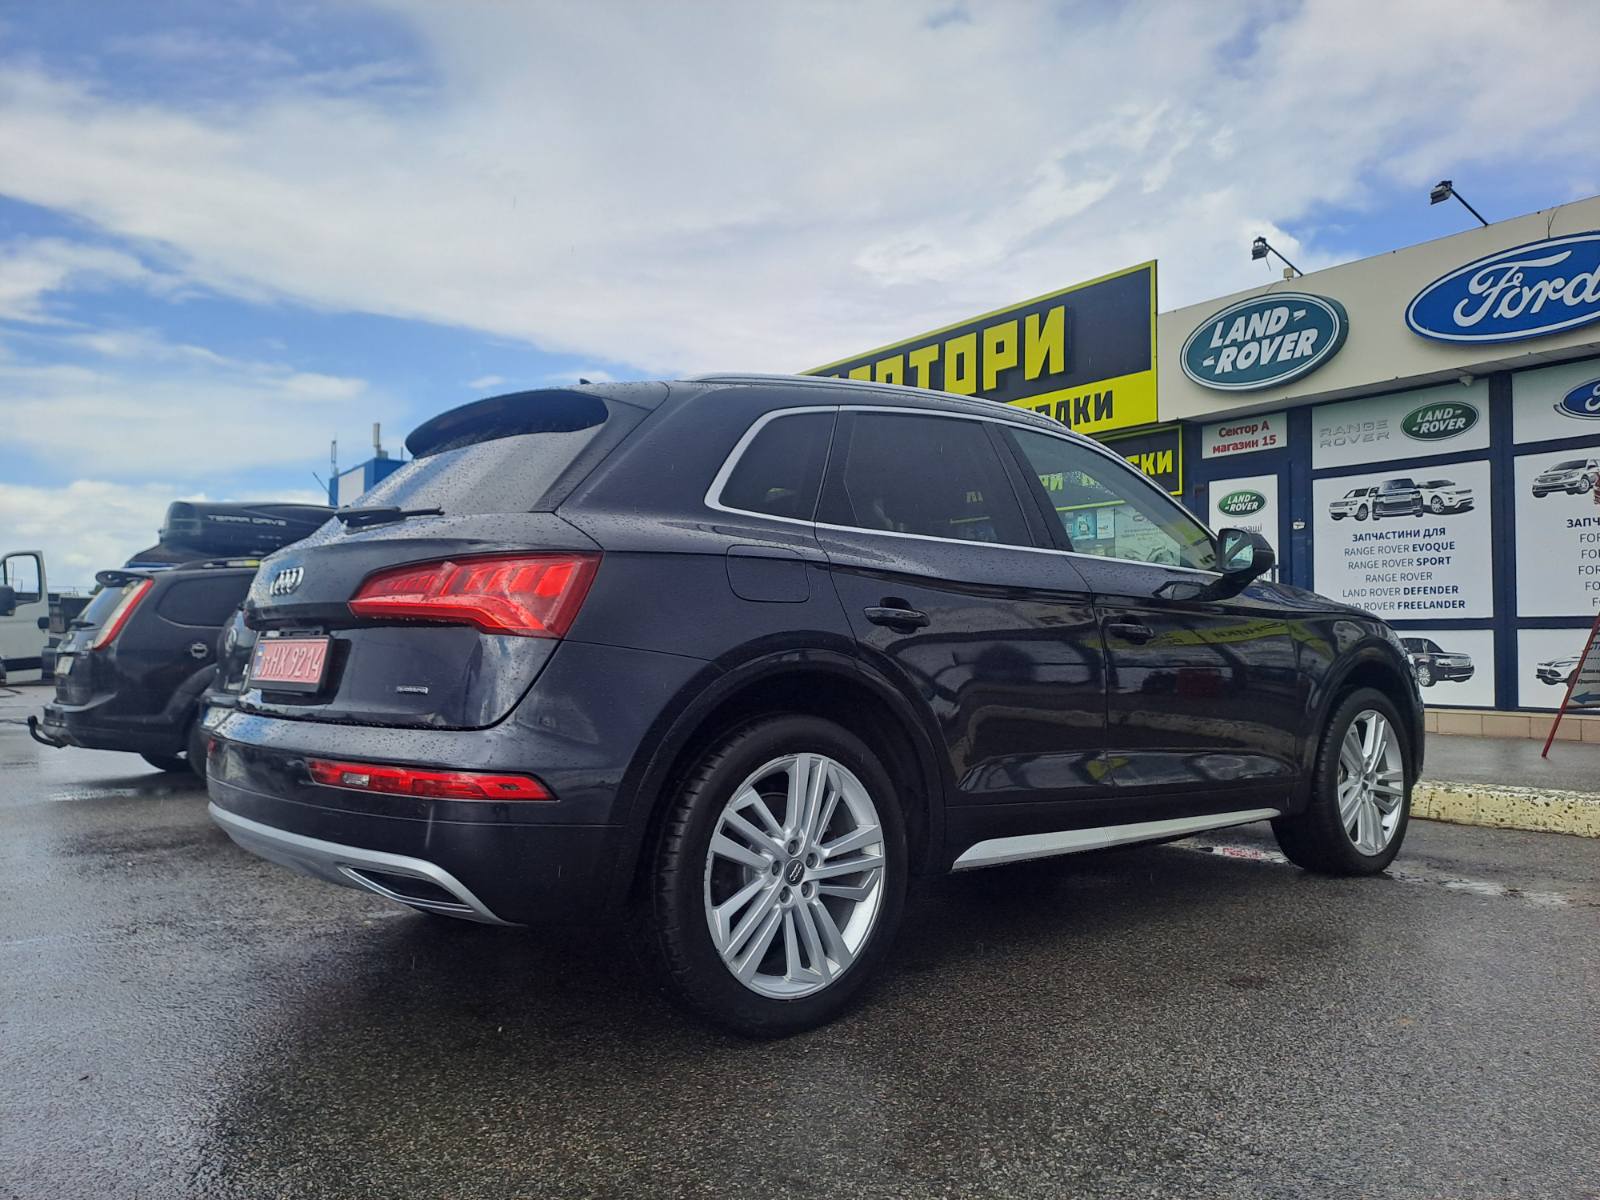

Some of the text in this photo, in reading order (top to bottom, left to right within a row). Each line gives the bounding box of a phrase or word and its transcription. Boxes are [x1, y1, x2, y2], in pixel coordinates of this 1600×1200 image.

[1453, 250, 1600, 327] Ford
[1218, 420, 1270, 438] Сектор А
[1319, 419, 1389, 438] RANGE
[1212, 434, 1277, 454] магазин 15
[1319, 432, 1390, 448] ROVER
[1352, 527, 1446, 543] ЗАПЧАСТИНИ ДЛЯ
[1344, 541, 1456, 557] RANGE ROVER EVOQUE
[1348, 556, 1452, 570] RANGE ROVER SPORT
[1365, 571, 1433, 583] RANGE ROVER
[1342, 585, 1459, 598] LAND ROVER DEFENDER
[1364, 601, 1395, 611] ROVER
[1397, 600, 1466, 610] FREELANDER
[287, 647, 324, 678] 9214
